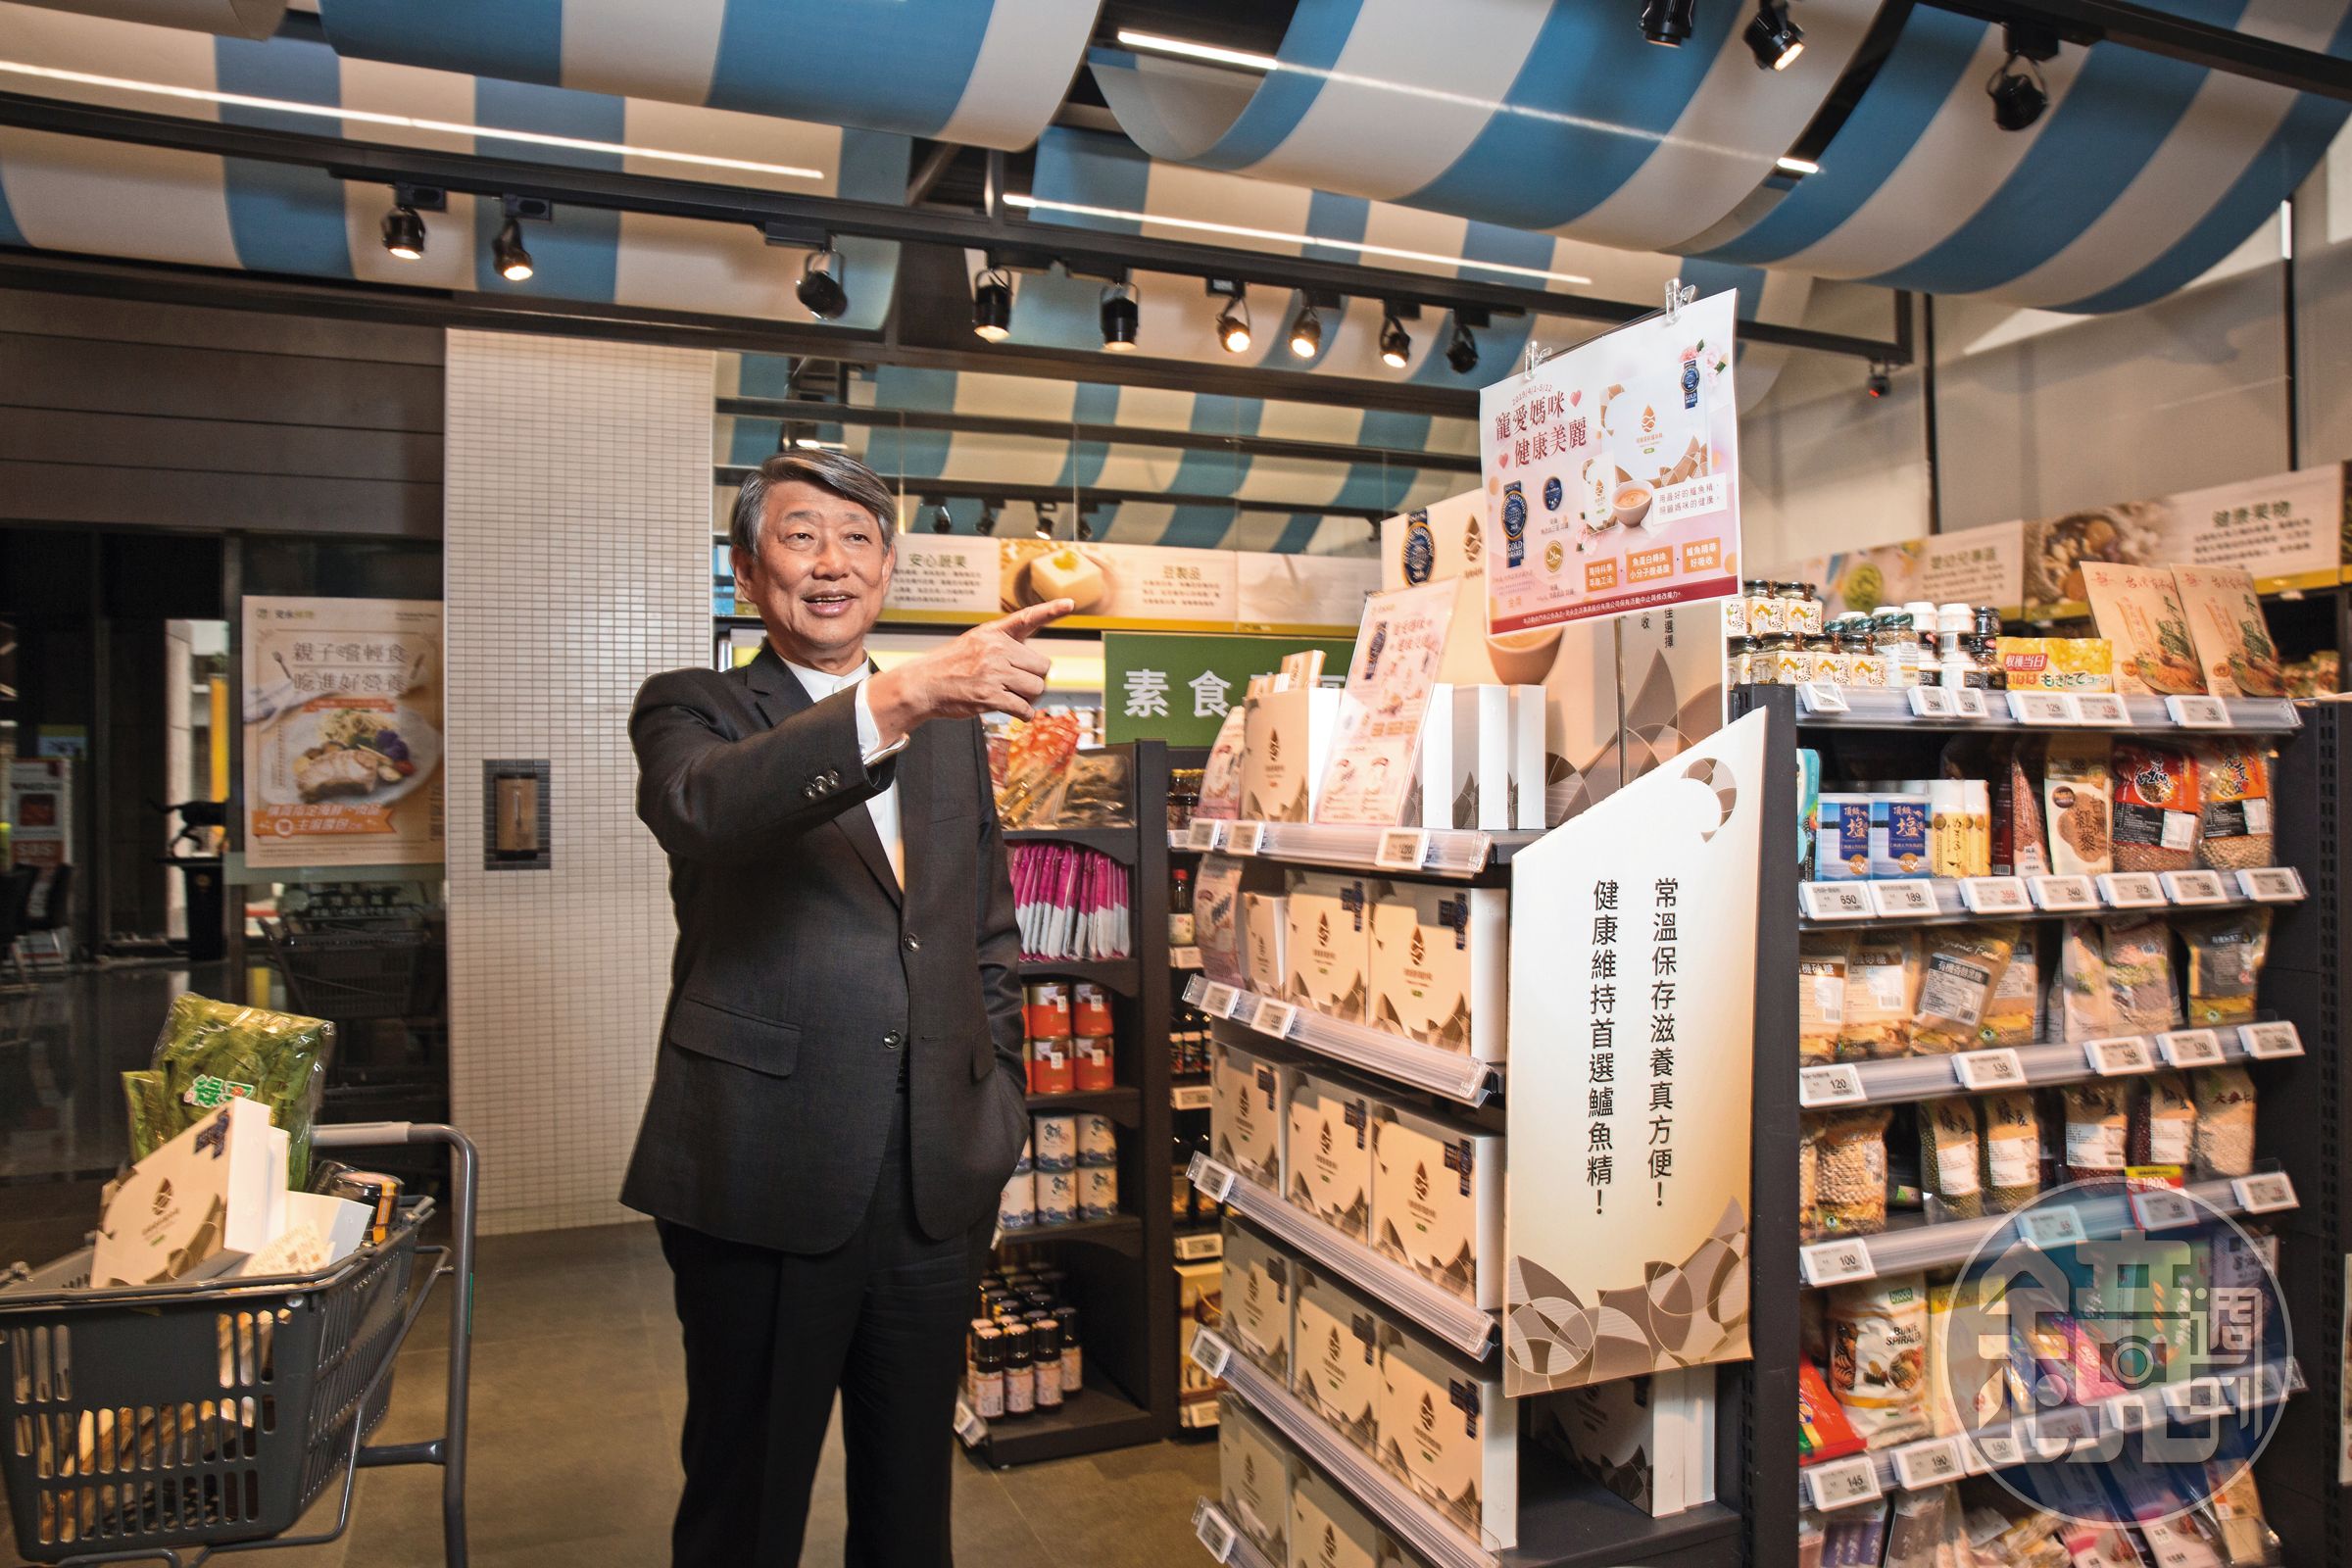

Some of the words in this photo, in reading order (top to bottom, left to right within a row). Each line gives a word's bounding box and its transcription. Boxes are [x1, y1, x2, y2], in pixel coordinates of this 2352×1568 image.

[1494, 390, 1565, 442] 寵愛媽咪
[1514, 416, 1587, 468] 健康美麗
[1839, 894, 1857, 905] 650
[1587, 879, 1619, 1216] 健康維持首選鱸魚精！
[1647, 878, 1679, 1207] 常溫保存滋養真方便！
[1830, 1078, 1847, 1090] 120
[1839, 1253, 1856, 1266] 100
[1846, 1474, 1863, 1487] 145
